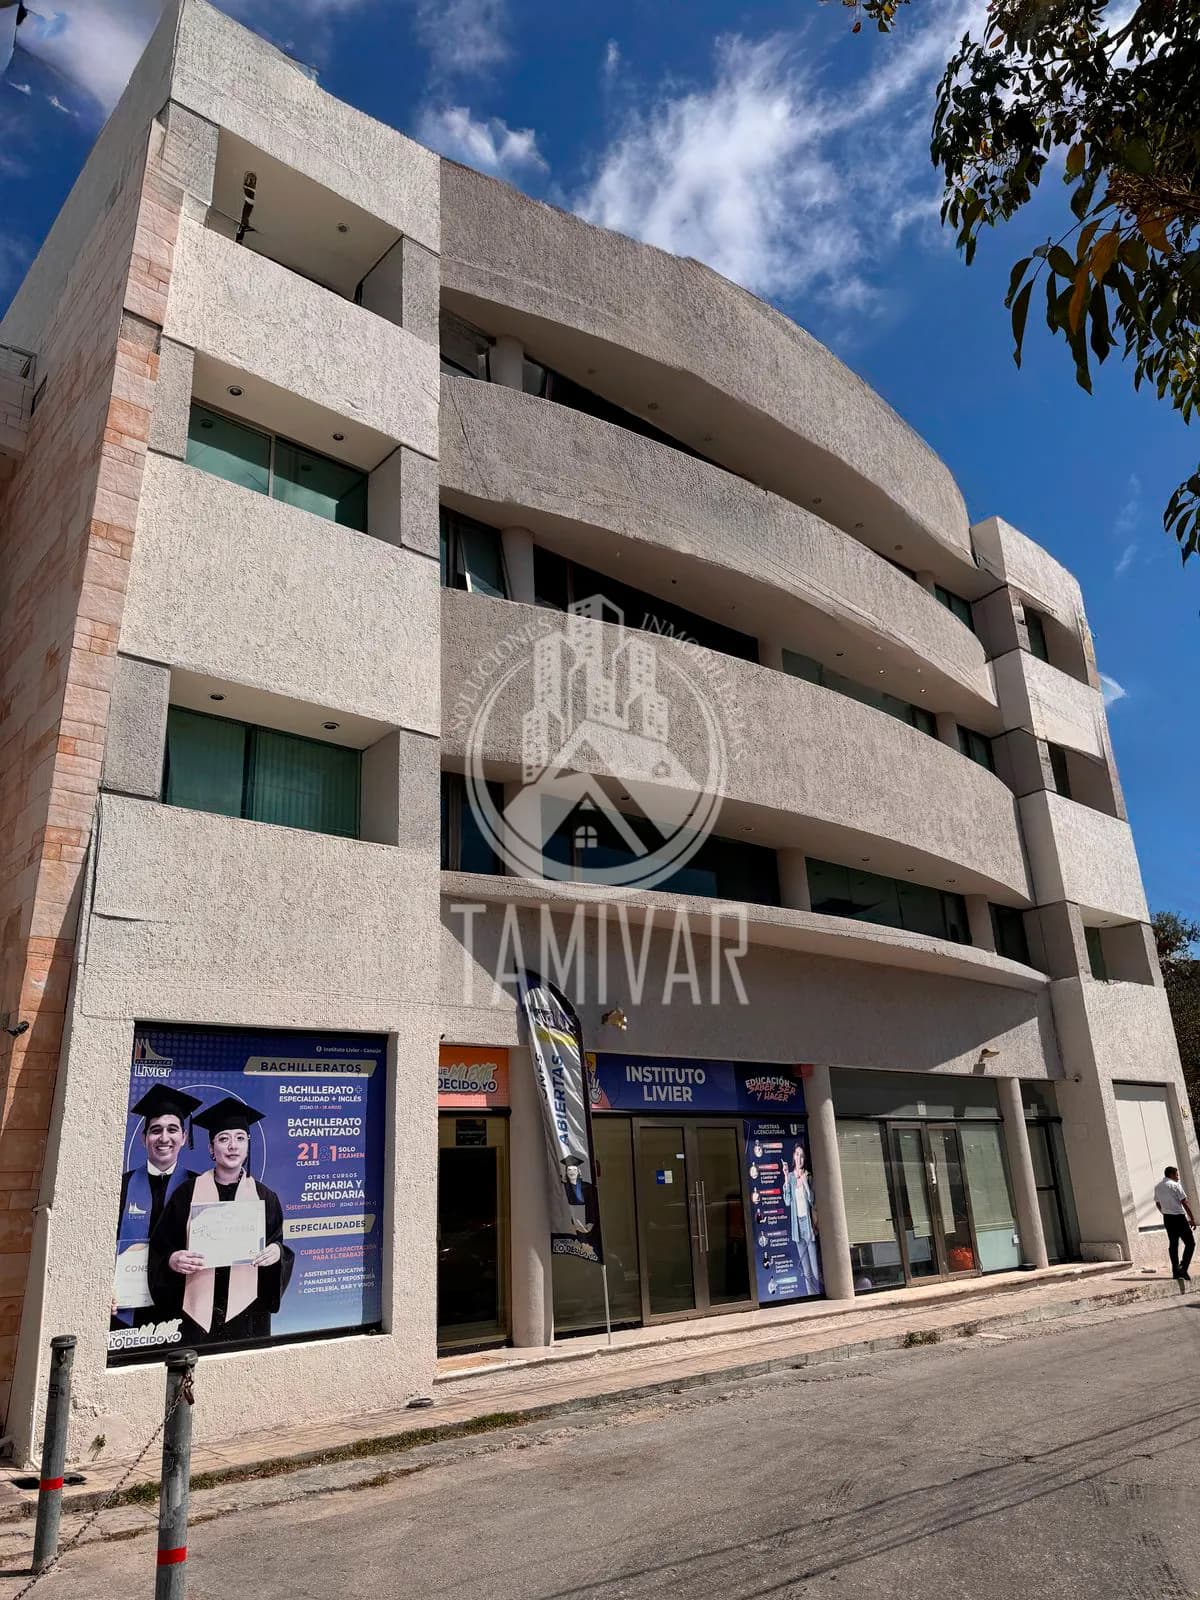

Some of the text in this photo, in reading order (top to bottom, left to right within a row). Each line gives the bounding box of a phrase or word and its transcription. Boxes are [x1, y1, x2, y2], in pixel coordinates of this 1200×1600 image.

[135, 1064, 172, 1078] Livier
[260, 1062, 362, 1073] BACHILLERATOS
[625, 1065, 706, 1084] INSTITUTO
[482, 1081, 496, 1090] YO
[745, 1076, 790, 1088] EDUCACIÓN
[279, 1085, 354, 1095] BACHILLERATO
[643, 1085, 693, 1102] LIVIER
[551, 1054, 571, 1147] ABIERTAS
[757, 1092, 762, 1101] Y
[287, 1118, 362, 1127] BACHILLERATO
[288, 1128, 360, 1137] GARANTIZADO
[297, 1142, 318, 1160] 21
[330, 1145, 337, 1162] 1
[304, 1180, 363, 1191] PRIMARIA Y
[301, 1190, 365, 1202] SECUNDARIA
[290, 1220, 366, 1233] ESPECIALIDADES
[304, 1276, 337, 1286] PANADERÍA
[109, 1334, 180, 1349] LO DECIDO YO
